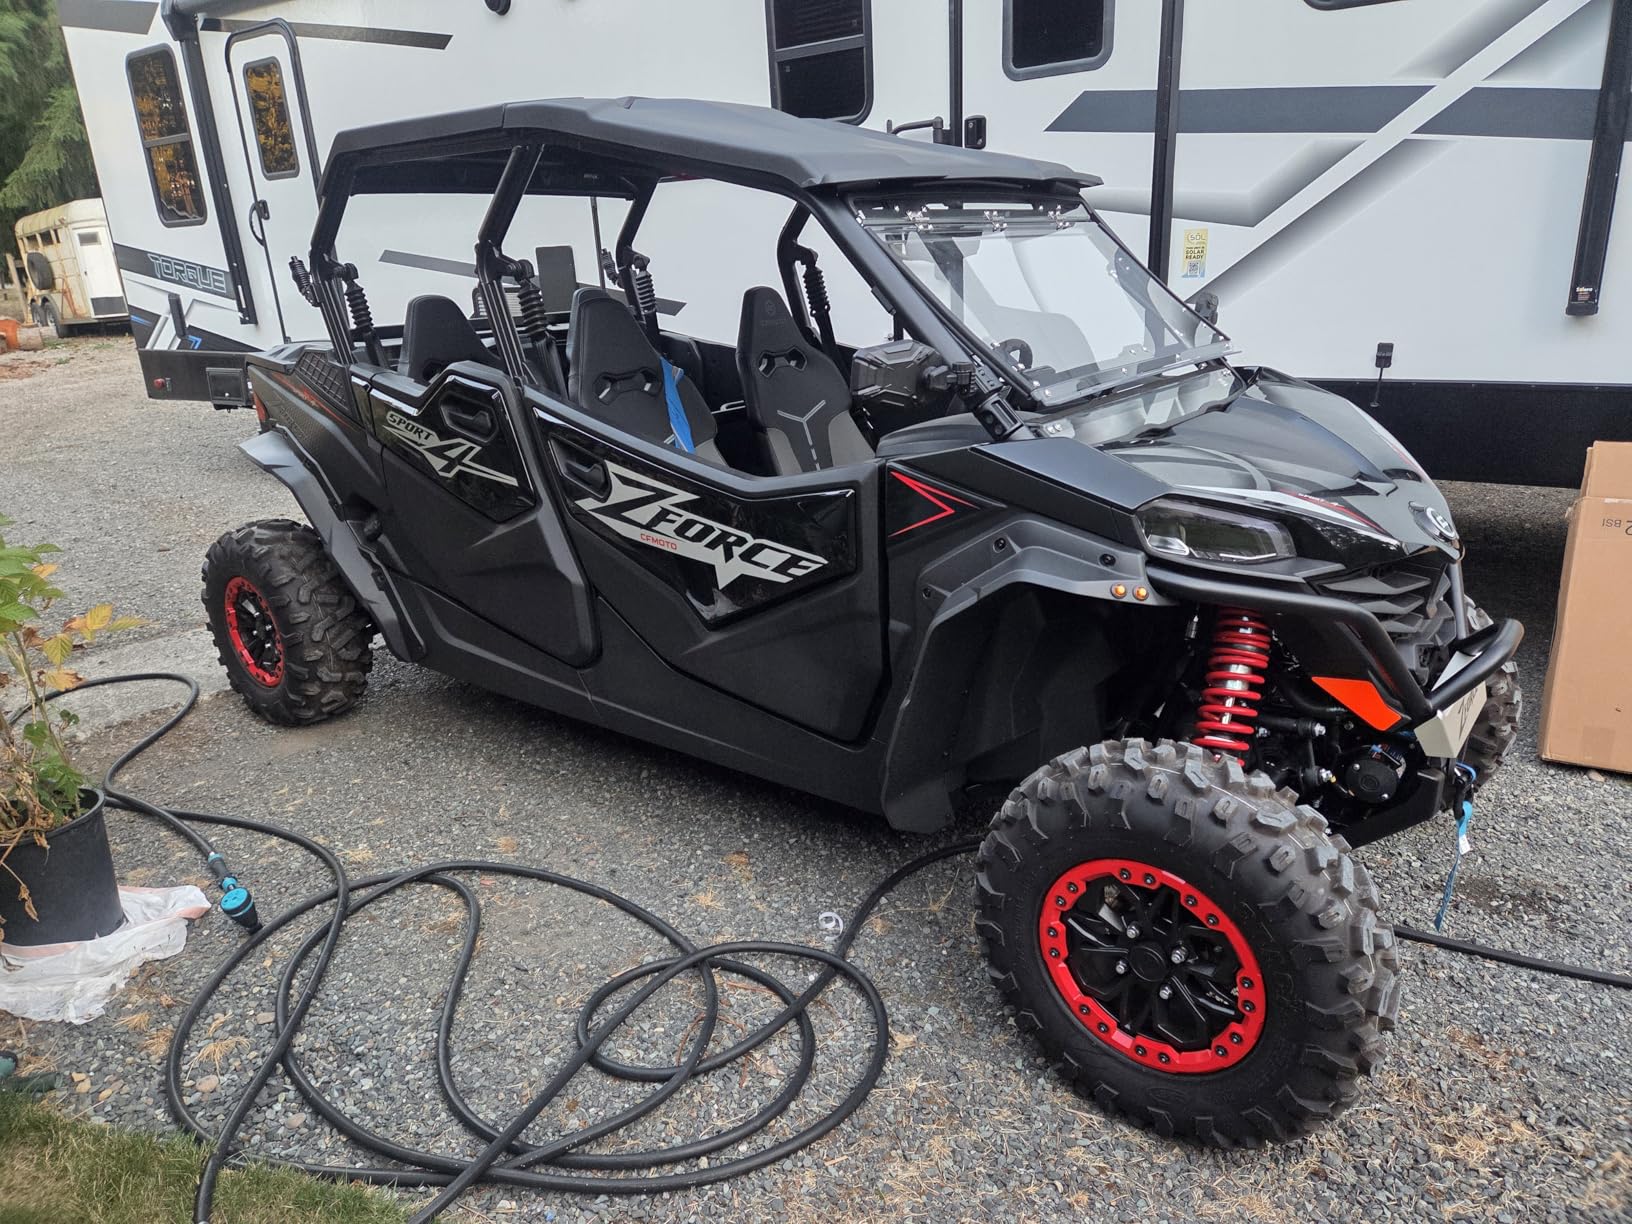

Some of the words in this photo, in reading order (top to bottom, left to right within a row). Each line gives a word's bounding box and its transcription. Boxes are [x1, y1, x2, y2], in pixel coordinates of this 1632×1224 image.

[147, 253, 227, 293] TORQUE
[388, 413, 434, 441] SPORT
[639, 532, 678, 551] CFMOTO
